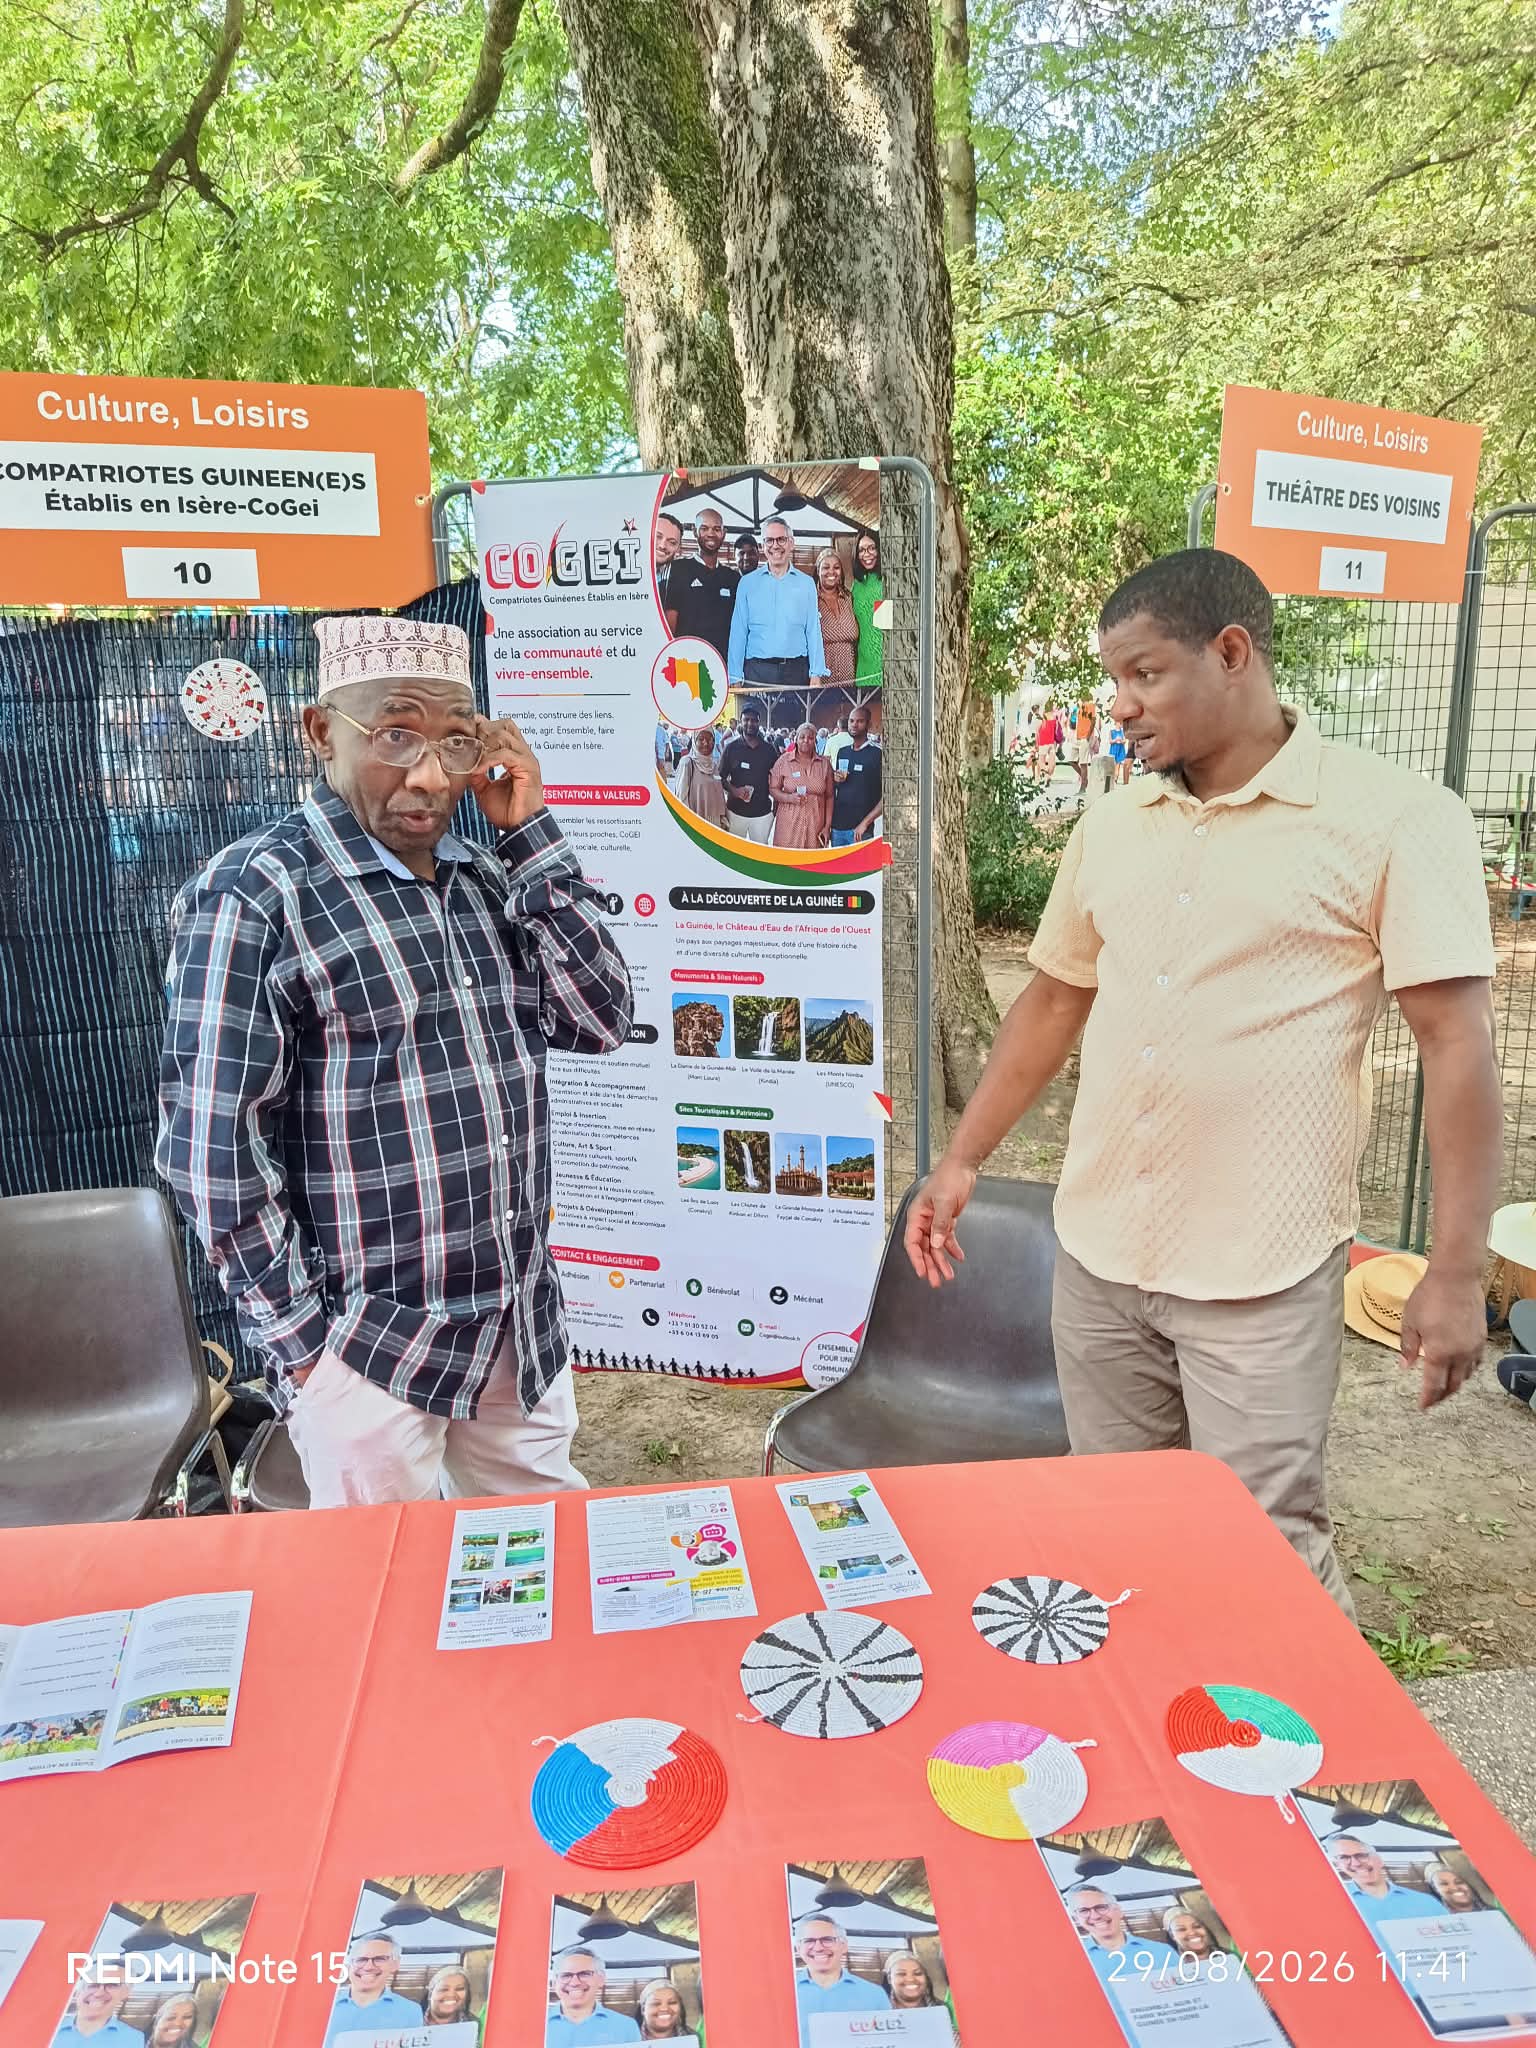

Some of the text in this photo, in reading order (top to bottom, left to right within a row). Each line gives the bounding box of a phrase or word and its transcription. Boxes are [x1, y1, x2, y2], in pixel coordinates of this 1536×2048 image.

[37, 390, 310, 429] Culture, Loisirs
[1297, 411, 1428, 454] Culture, Loisirs
[0, 462, 367, 491] OMPATRIOTES GUINEEN(E)S
[45, 488, 319, 517] Établis en Isère-CoGei
[1267, 480, 1441, 519] THÉÂTRE DES VOISINS
[174, 562, 211, 584] 10
[1345, 561, 1363, 580] 11
[490, 595, 541, 605] Compatriotes
[544, 594, 585, 603] Guinéenes
[588, 592, 615, 602] Établis
[629, 592, 649, 601] Isère
[493, 625, 643, 639] Une association au service
[494, 646, 636, 660] de la communauté et du
[495, 664, 593, 680] vivre-ensemble.
[539, 711, 578, 719] construire
[579, 711, 593, 719] des
[595, 711, 614, 719] liens.
[557, 726, 596, 735] Ensemble,
[598, 727, 615, 735] faire
[535, 742, 541, 750] la
[543, 741, 570, 750] Guinée
[583, 742, 604, 750] Isère.
[543, 790, 641, 800] ÉSENTATION & VALEURS
[619, 830, 641, 838] CoGEI
[681, 891, 843, 907] À LA DÉCOUVERTE DE LA GUINÉE
[675, 921, 684, 929] La
[686, 922, 715, 930] Guinée,
[725, 922, 758, 931] Château
[760, 924, 781, 932] d'Eau
[795, 925, 828, 934] l'Afrique
[843, 926, 871, 934] l'Ouest
[551, 1248, 644, 1267] CONTACT & ENGAGEMENT
[561, 1270, 823, 1304] Adhésion Partenariat Bénévolat Mécénat
